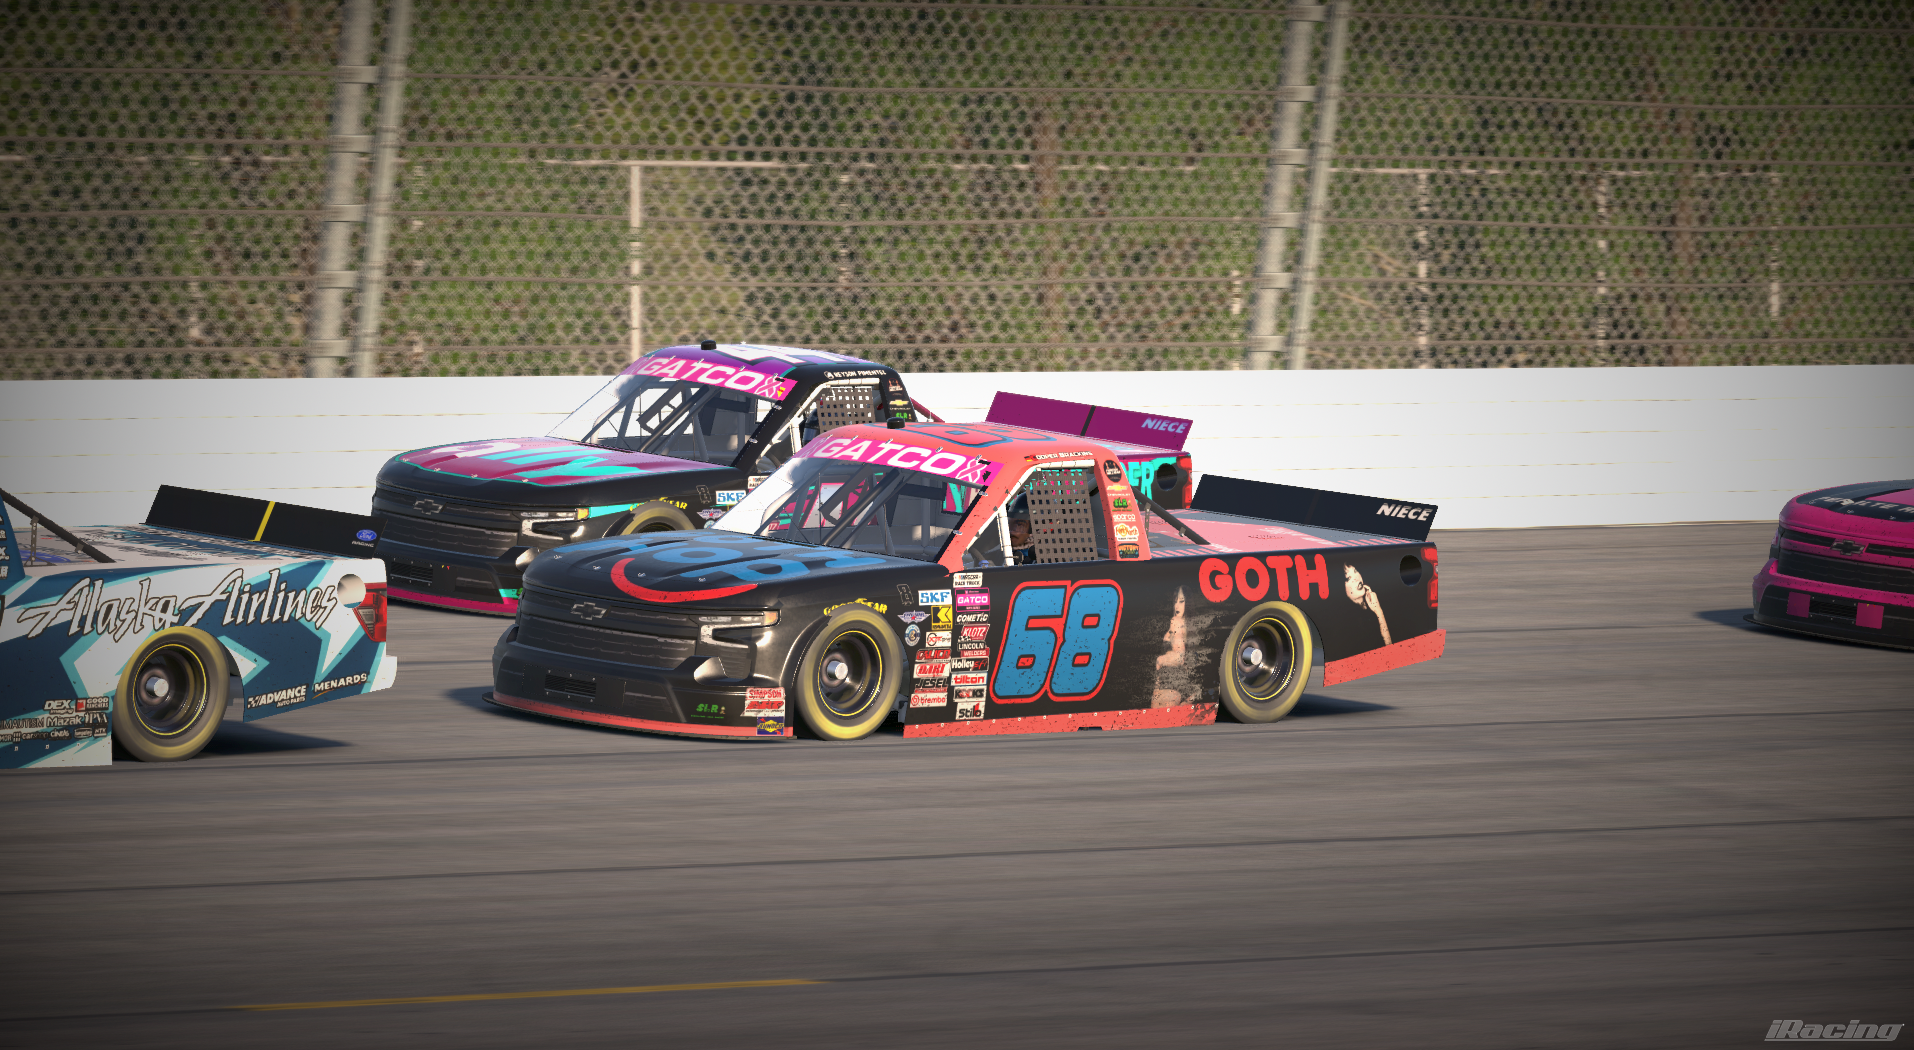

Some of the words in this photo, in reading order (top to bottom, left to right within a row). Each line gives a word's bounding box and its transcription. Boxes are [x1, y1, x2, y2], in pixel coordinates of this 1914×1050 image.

[636, 358, 765, 390] GATCO
[1140, 417, 1189, 434] NIECE
[813, 438, 967, 475] GATCO
[1113, 498, 1128, 508] SLR
[1375, 502, 1434, 522] NIECE
[1198, 553, 1330, 603] GOTH
[919, 591, 951, 604] SKF
[957, 595, 989, 604] GATCO
[17, 576, 182, 643] Alaska
[178, 568, 338, 631] Airlines
[956, 613, 989, 622] COMETIC
[962, 626, 987, 637] KLOTZ
[958, 642, 985, 650] LINCOLN
[989, 578, 1124, 705] 68
[951, 659, 974, 671] Holley
[314, 673, 368, 693] MENARDS
[915, 678, 948, 688] JESEL
[953, 675, 985, 684] tilton
[258, 684, 307, 706] ADVANCE
[748, 687, 782, 699] SIMPSON
[44, 699, 71, 710] DEX
[920, 696, 946, 704] brembo
[695, 703, 719, 713] SLR
[46, 714, 82, 727] Mazak
